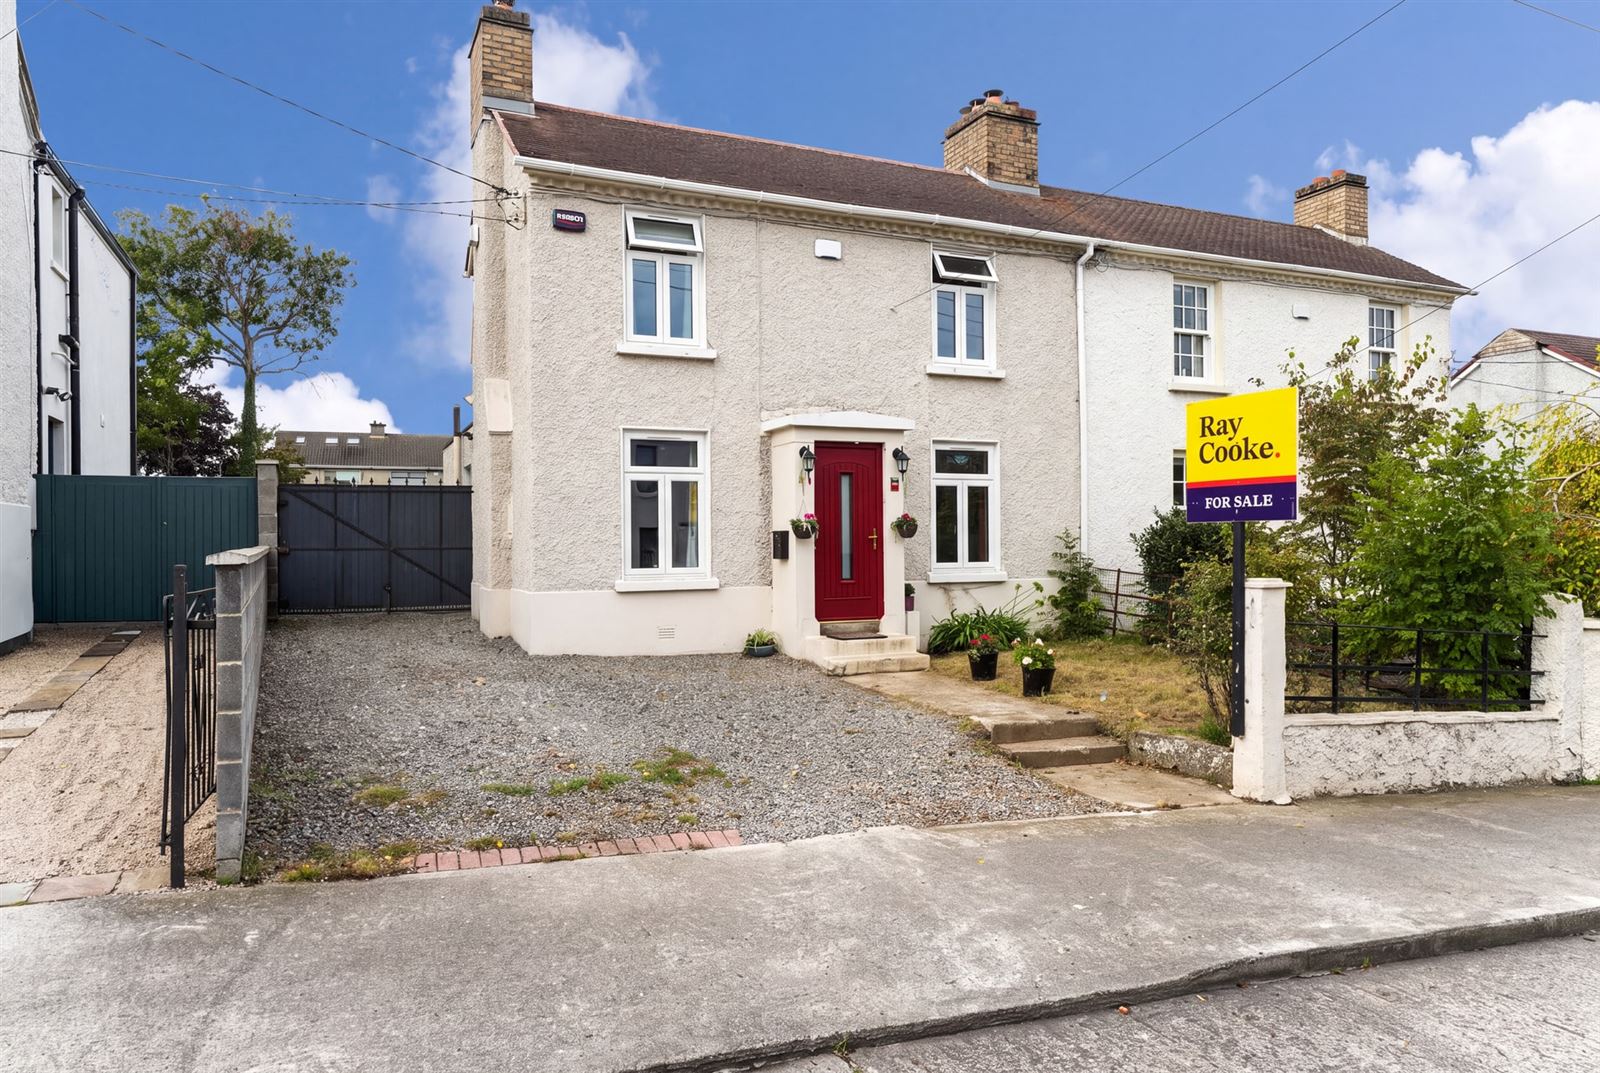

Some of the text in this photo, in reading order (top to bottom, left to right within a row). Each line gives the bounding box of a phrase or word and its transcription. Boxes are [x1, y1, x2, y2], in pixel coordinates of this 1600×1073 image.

[1199, 415, 1243, 441] Ray
[1204, 494, 1273, 509] FOR SALE
